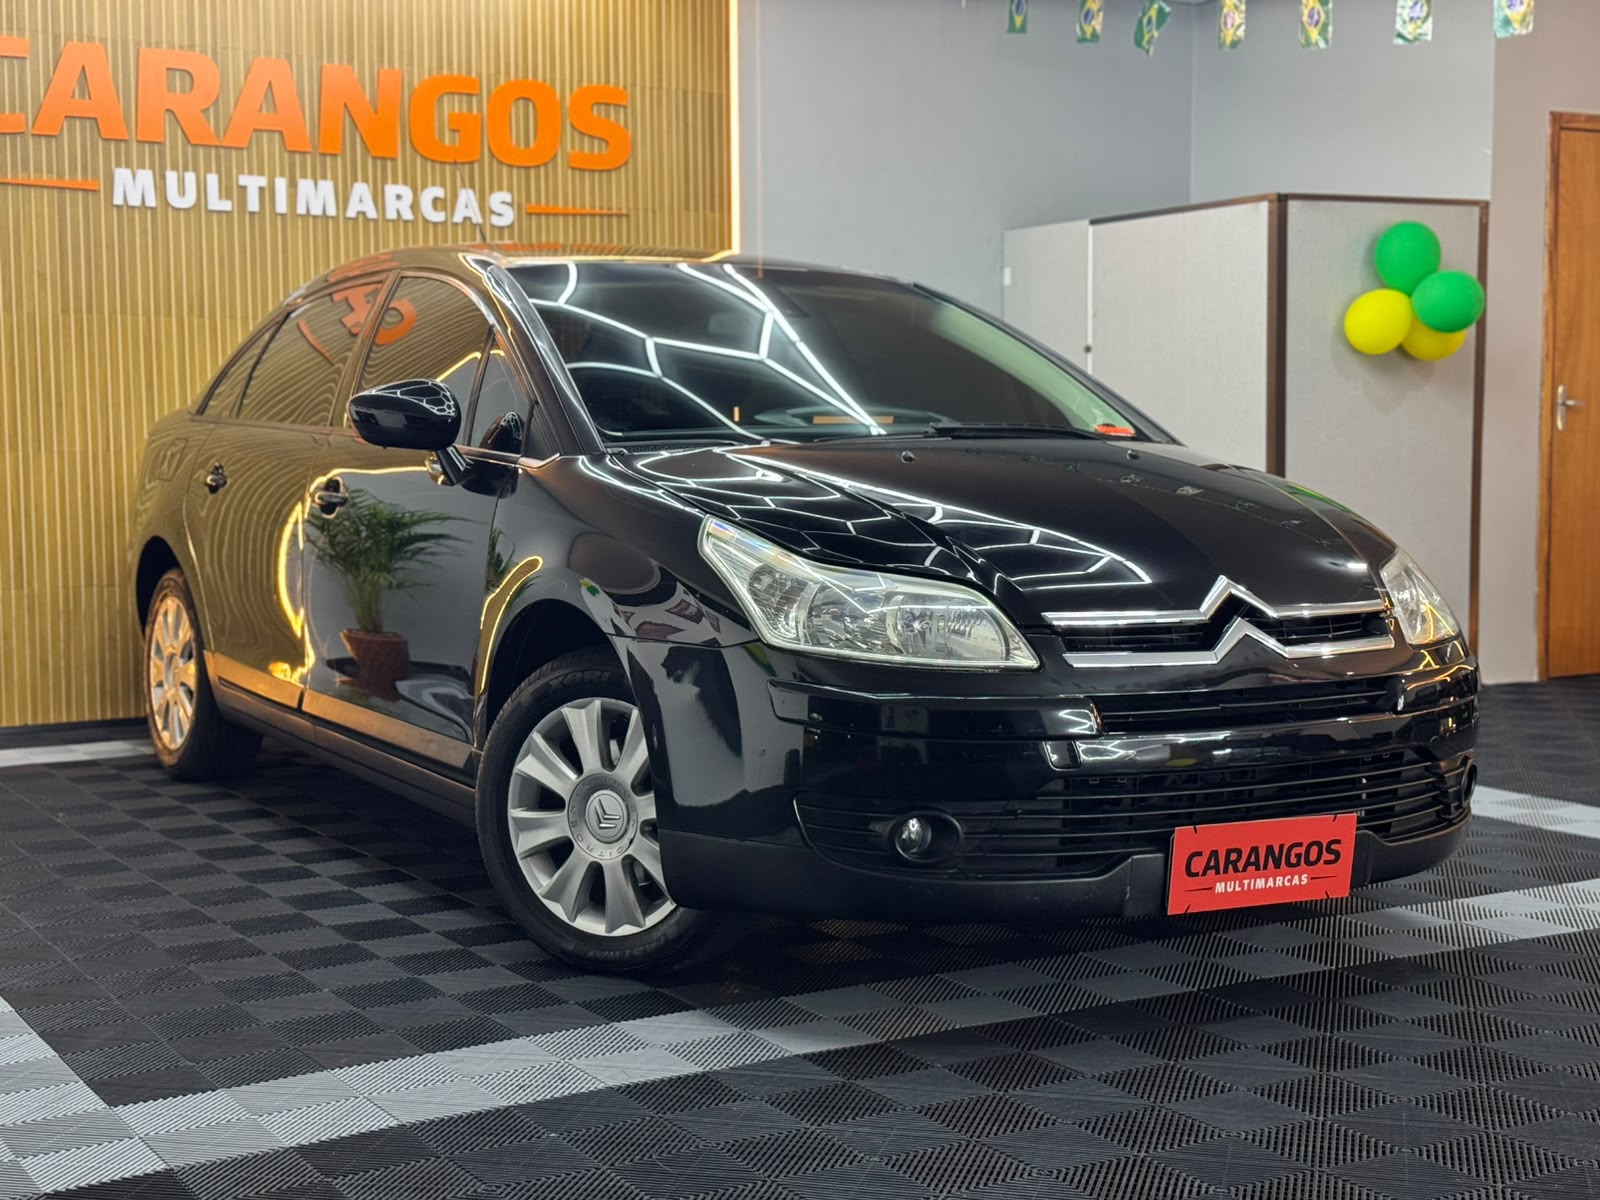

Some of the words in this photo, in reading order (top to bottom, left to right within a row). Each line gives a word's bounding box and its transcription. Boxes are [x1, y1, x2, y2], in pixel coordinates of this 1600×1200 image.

[112, 167, 515, 227] MULTIMARCAS
[1184, 838, 1342, 878] CARANGOS
[1214, 873, 1308, 893] MULTIMARCAS
